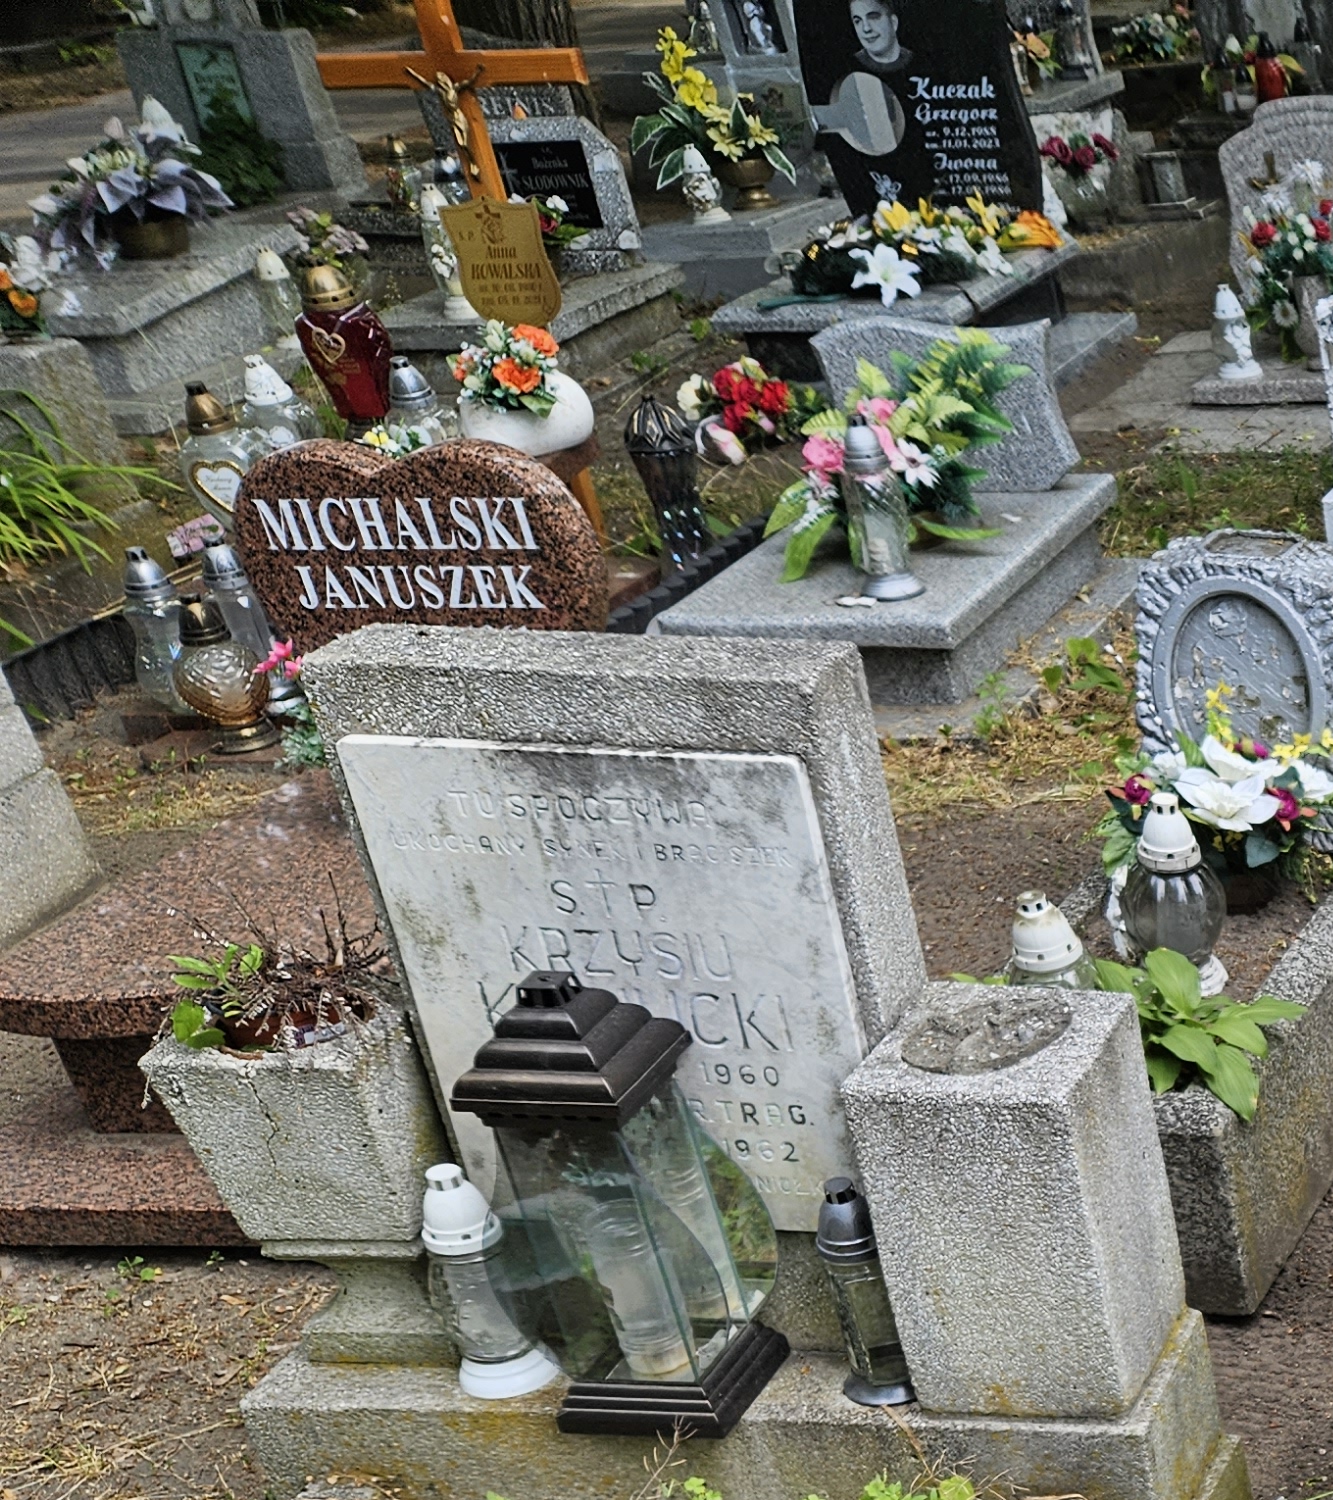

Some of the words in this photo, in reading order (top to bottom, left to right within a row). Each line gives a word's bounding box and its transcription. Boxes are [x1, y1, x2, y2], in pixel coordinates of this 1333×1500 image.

[908, 75, 996, 100] Kuczak
[915, 102, 999, 125] Grzegorz
[933, 153, 998, 170] Iwona
[251, 496, 540, 551] MICHALSKI
[294, 565, 547, 610] JANUSZEK
[447, 789, 496, 819] TU
[508, 794, 714, 830] SPOCZYWA
[390, 829, 527, 857] UKOCHANY
[541, 837, 632, 862] SYNEK
[653, 843, 794, 869] BRACISZEK
[501, 925, 735, 981] KRZYSIU
[700, 1062, 780, 1087] 1960
[722, 1137, 801, 1163] 1962
